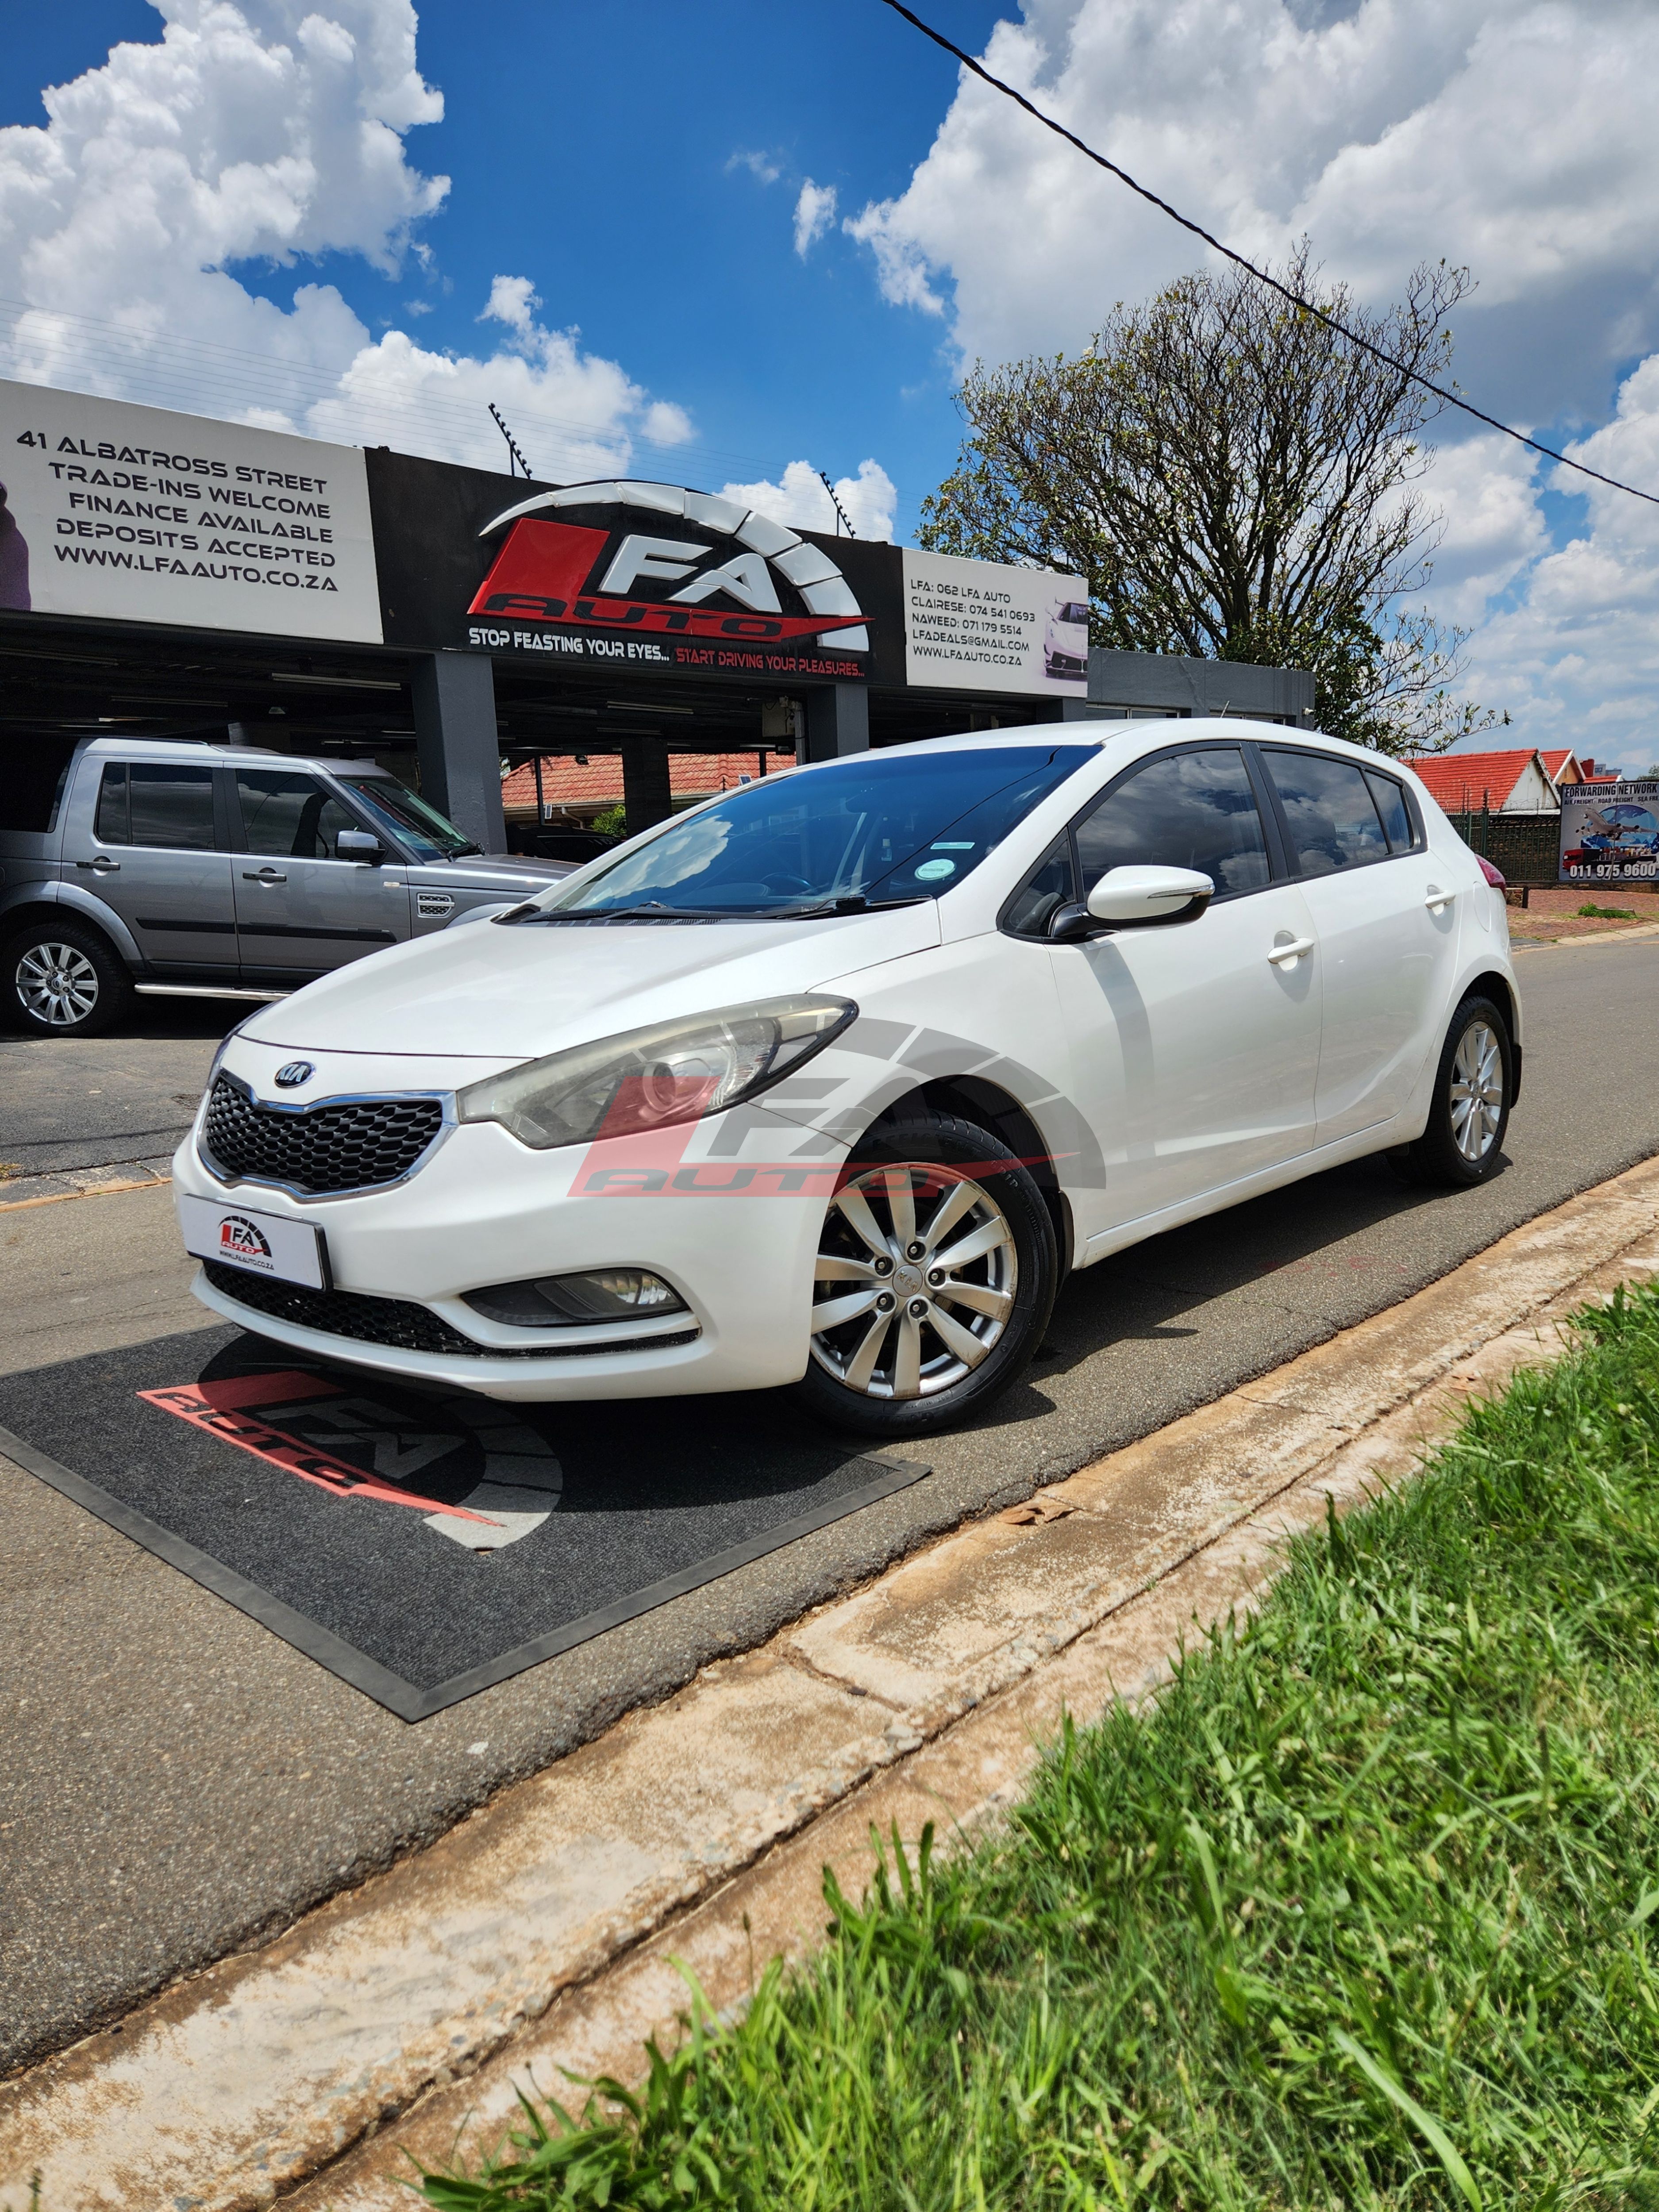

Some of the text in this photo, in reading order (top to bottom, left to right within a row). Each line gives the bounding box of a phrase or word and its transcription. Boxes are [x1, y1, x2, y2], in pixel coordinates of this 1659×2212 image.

[16, 431, 328, 494] 41 ALBATROSS STREET
[48, 462, 331, 519] TRADE-INS WELCOME
[69, 492, 334, 543] FINANCE AVAILABLE
[56, 518, 336, 567] DEPOSITS ACCEPTED
[54, 544, 339, 592] WWW.LFAAUTO.CO.ZA
[468, 518, 782, 613] LFA
[911, 579, 1010, 603] LFA: 062 LFA AUTO
[483, 593, 782, 636] AUTO
[911, 596, 1035, 622] CLAIRESE: 074 541 0693
[912, 613, 1022, 635] NAWEED: 071 179 5514
[469, 628, 510, 646] STOP
[514, 632, 583, 653] FEASTING
[586, 639, 625, 657] YOUR
[628, 642, 670, 662] EYES...
[675, 647, 714, 665] START
[718, 651, 764, 669] DRIVING
[767, 656, 796, 671] YOUR
[912, 630, 1029, 651] LFADEALS@GMAIL.COM
[913, 646, 1022, 666] WWW.LFAAUTO.CO.ZA
[1565, 784, 1657, 797] FORWARDING NETWORK
[1570, 864, 1656, 877] 011 975 9600
[276, 1064, 308, 1082] KIA
[221, 1224, 255, 1247] LFA
[222, 1241, 255, 1254] AUTO
[897, 1270, 917, 1292] KIA
[156, 1393, 368, 1489] AUTO
